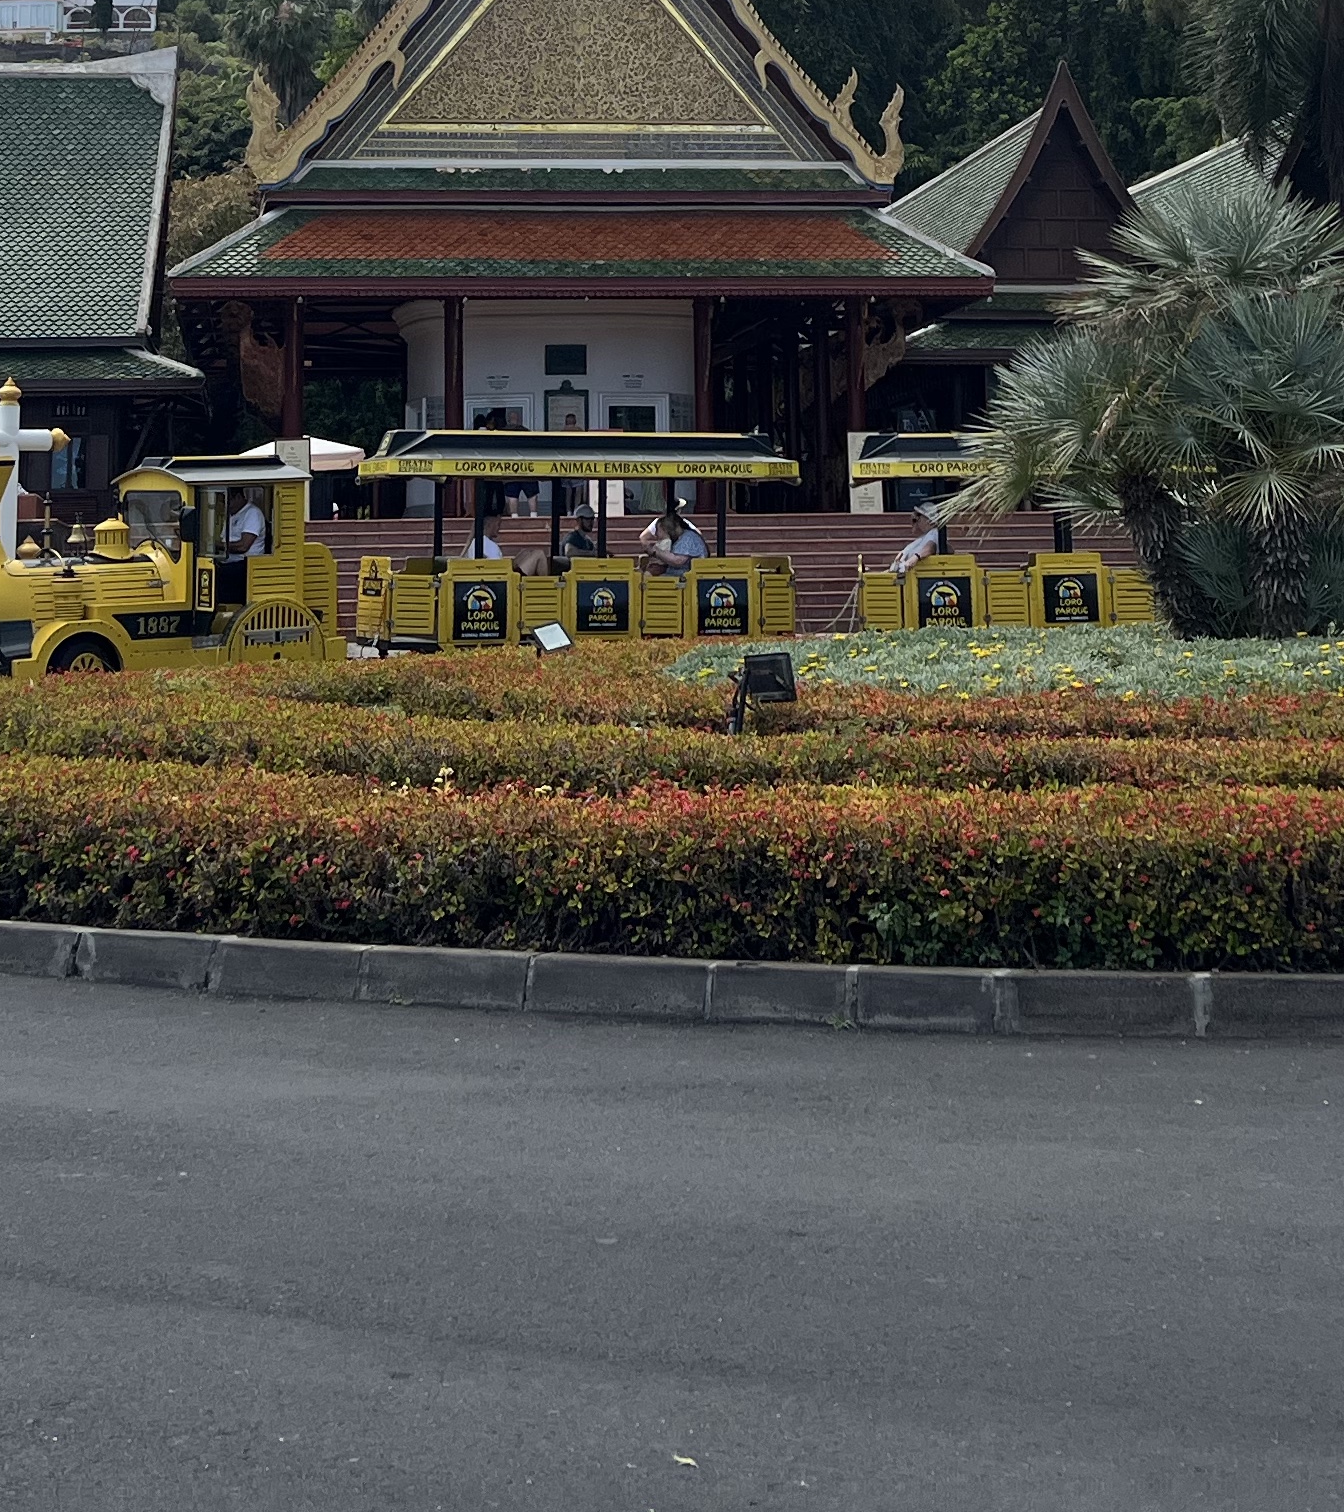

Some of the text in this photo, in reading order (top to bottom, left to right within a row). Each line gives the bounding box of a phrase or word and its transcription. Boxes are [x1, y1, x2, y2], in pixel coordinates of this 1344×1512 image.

[398, 459, 433, 467] GRATIS
[455, 461, 535, 473] LORO PARQUE
[550, 462, 662, 474] ANIMAL EMBASSY
[912, 463, 944, 473] LORO
[676, 463, 753, 474] LORO PARQUE
[1059, 598, 1082, 606] LORO
[467, 610, 494, 620] LORO
[710, 607, 735, 617] LORO
[931, 606, 959, 616] LORO
[1054, 606, 1088, 615] PARQUE
[588, 614, 617, 622] PARQUE
[704, 617, 741, 627] PARQUE
[137, 615, 181, 634] 1887
[460, 621, 499, 631] PARQUE
